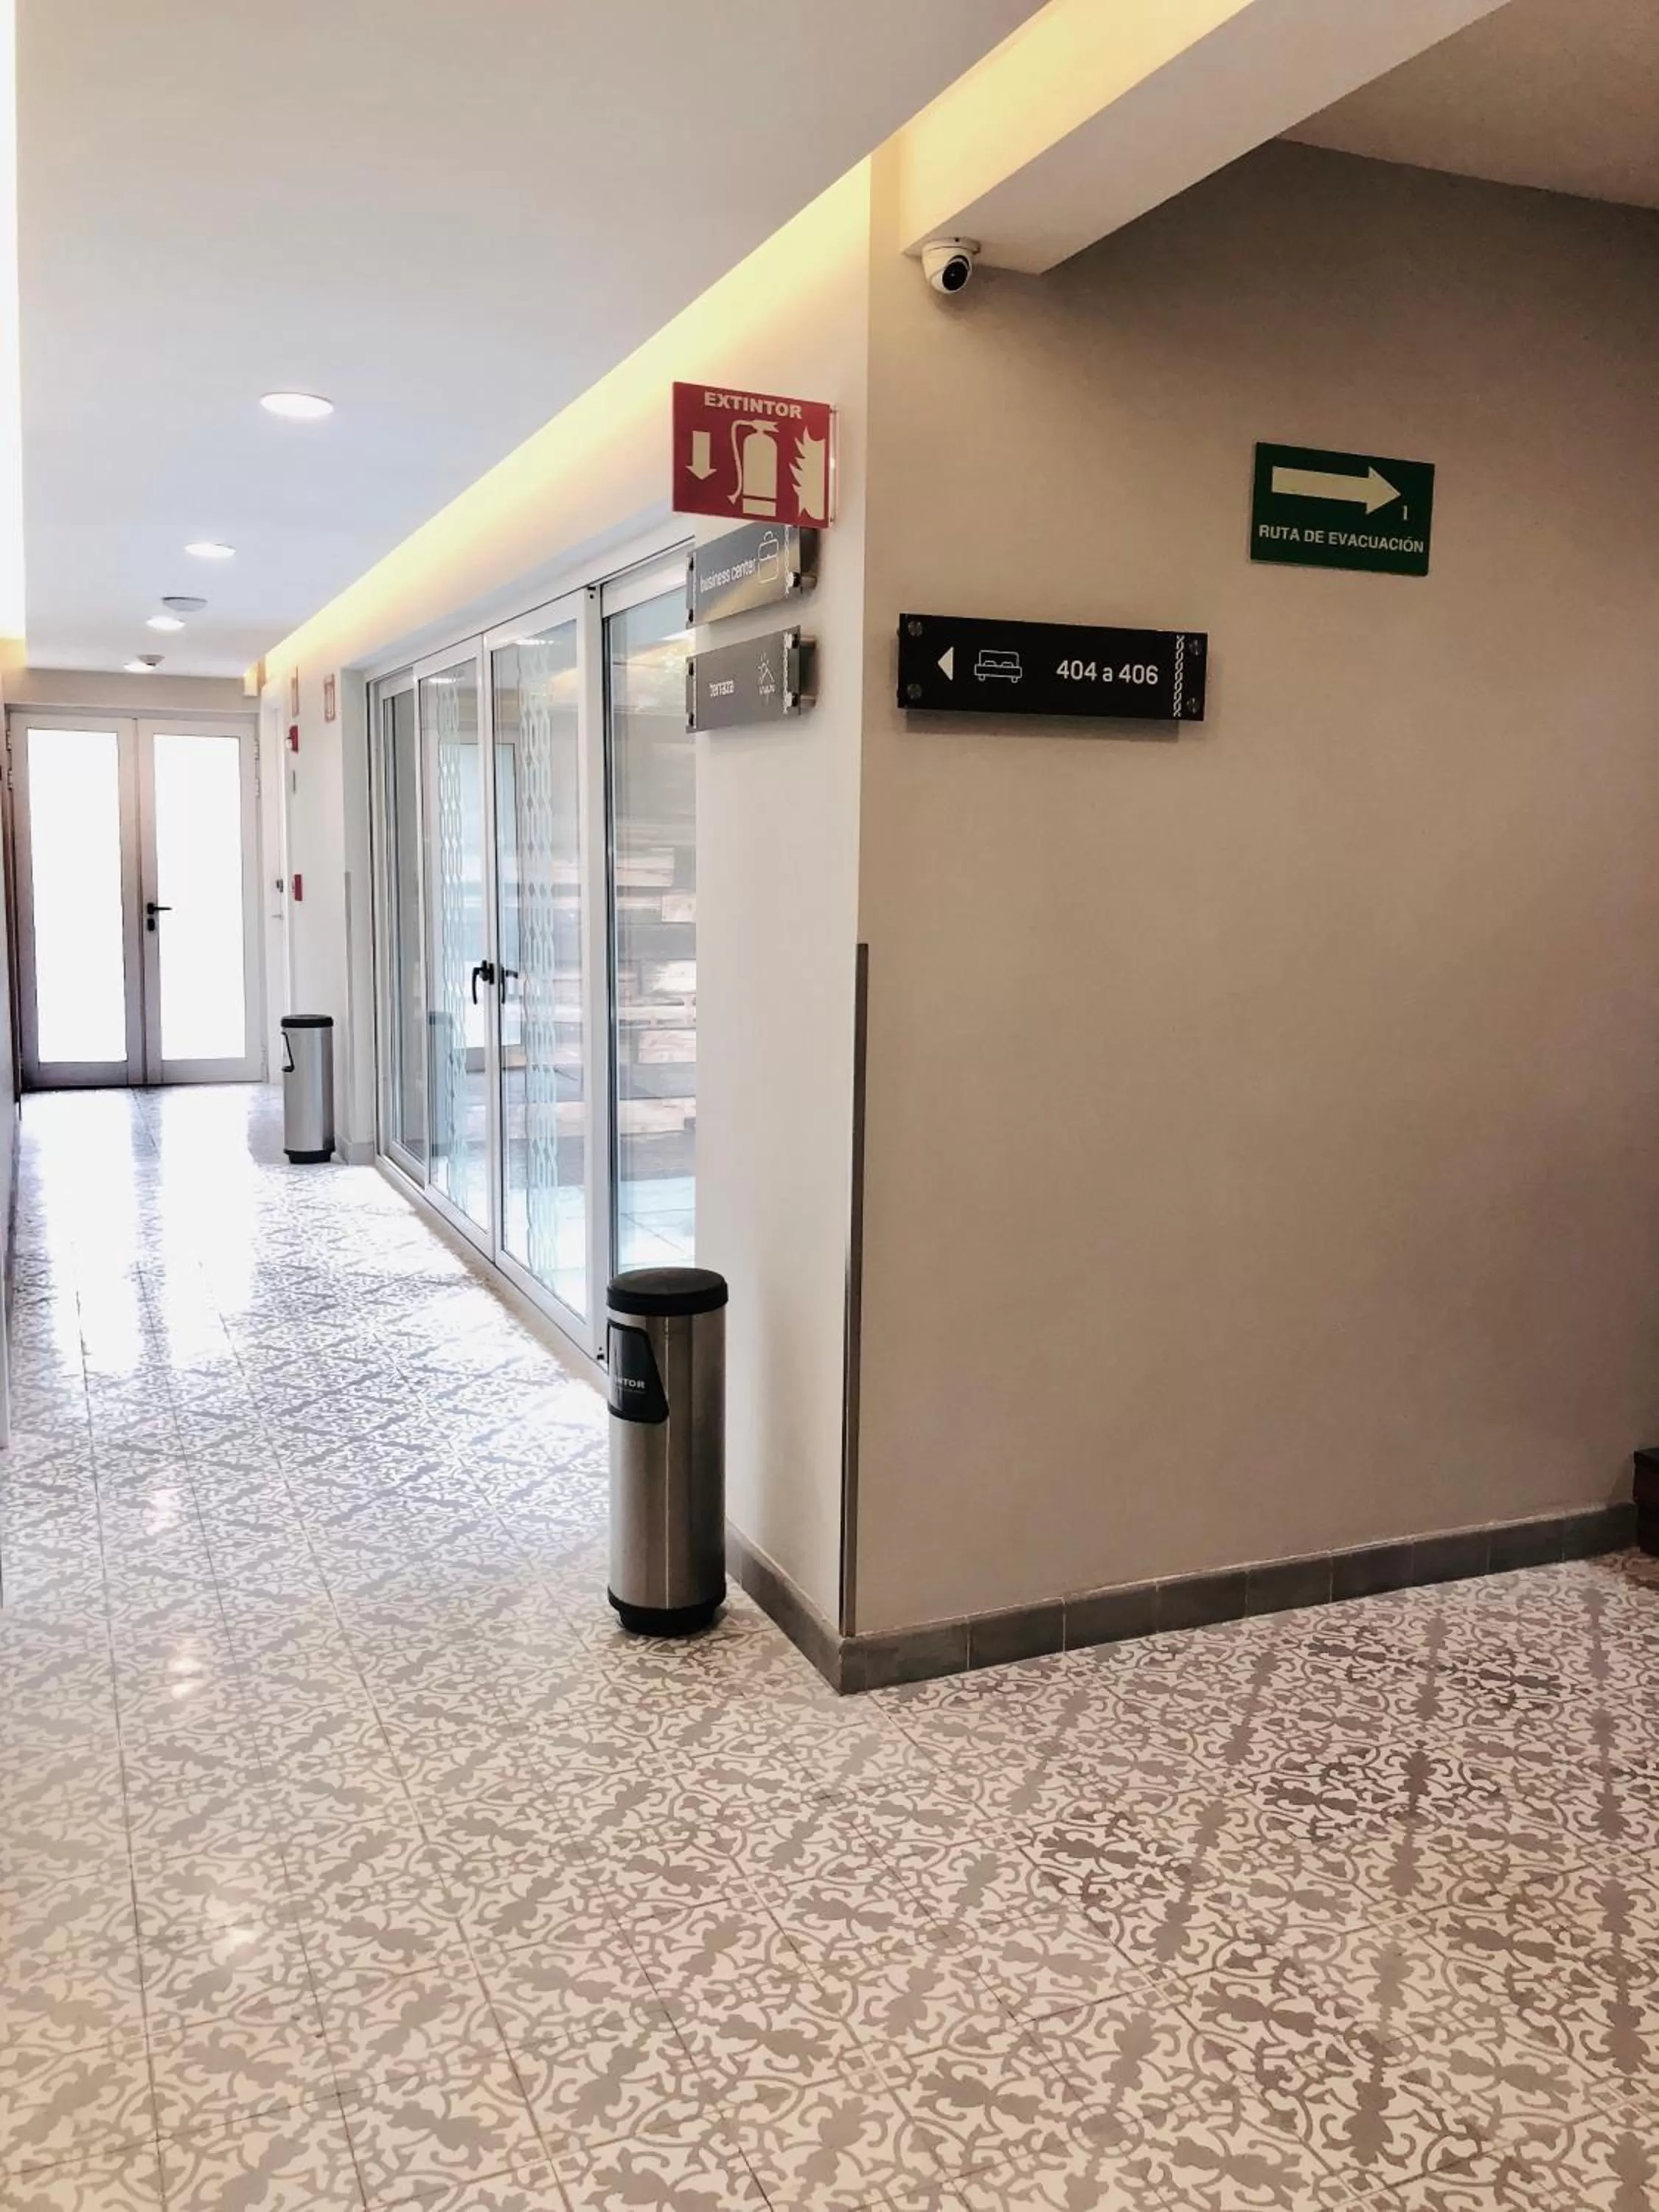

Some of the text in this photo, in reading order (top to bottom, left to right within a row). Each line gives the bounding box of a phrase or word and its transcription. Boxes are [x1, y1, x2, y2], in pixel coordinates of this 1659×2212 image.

[704, 391, 802, 420] EXTINTOR
[1259, 524, 1425, 553] RUTA DE EVACUACIÓN
[700, 558, 757, 593] business center
[1056, 659, 1159, 685] 404 a 406
